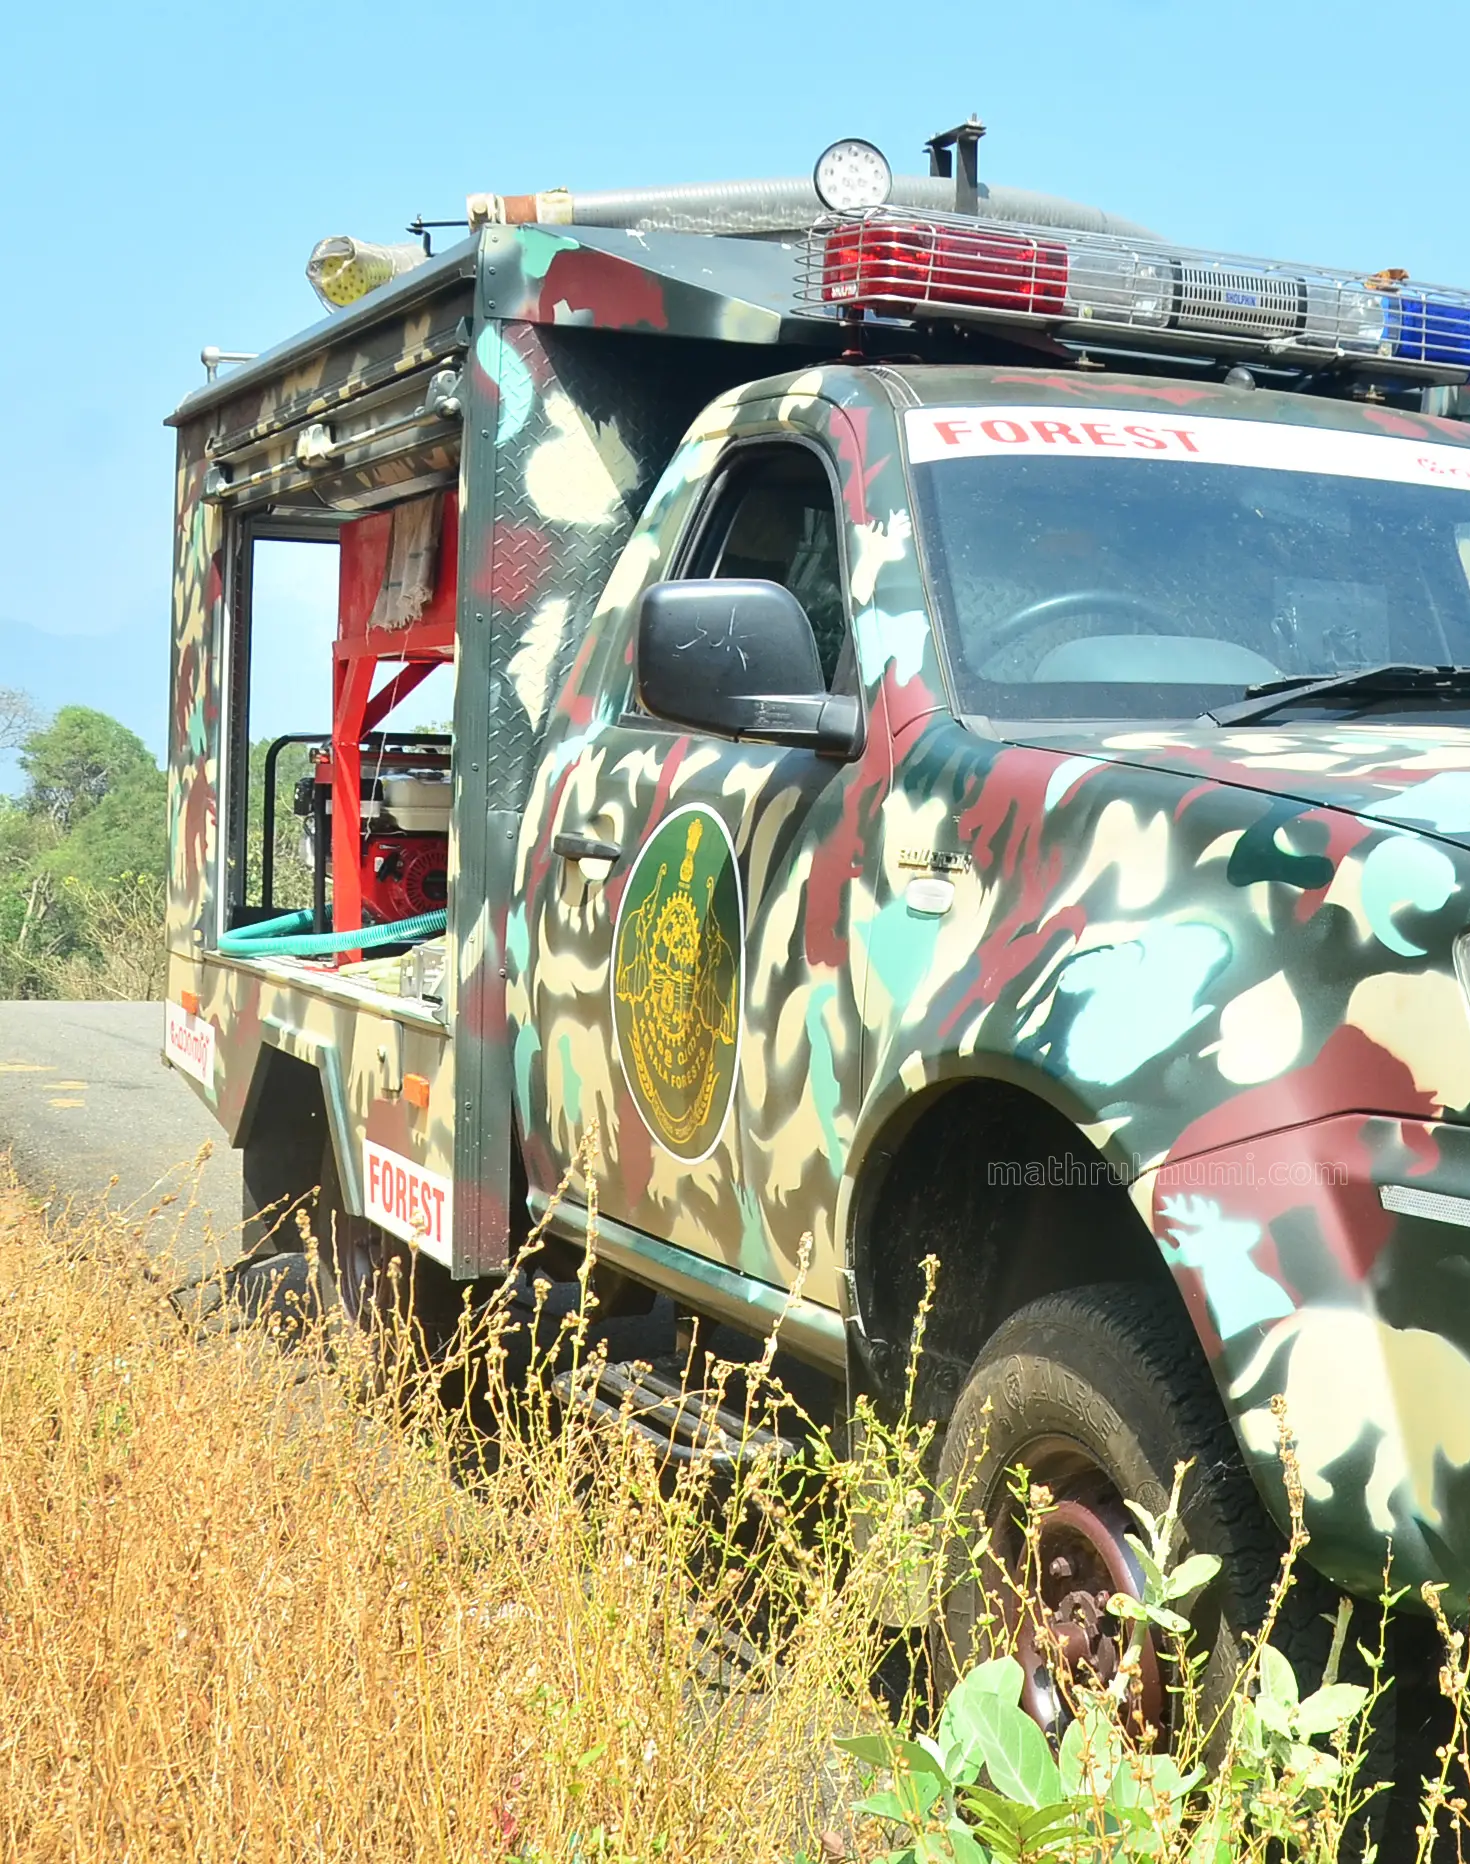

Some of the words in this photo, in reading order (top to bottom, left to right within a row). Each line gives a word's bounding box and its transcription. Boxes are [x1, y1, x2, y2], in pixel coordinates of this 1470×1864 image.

[932, 419, 1200, 452] FOREST
[670, 1046, 706, 1090] FORESTS
[369, 1153, 445, 1243] FOREST
